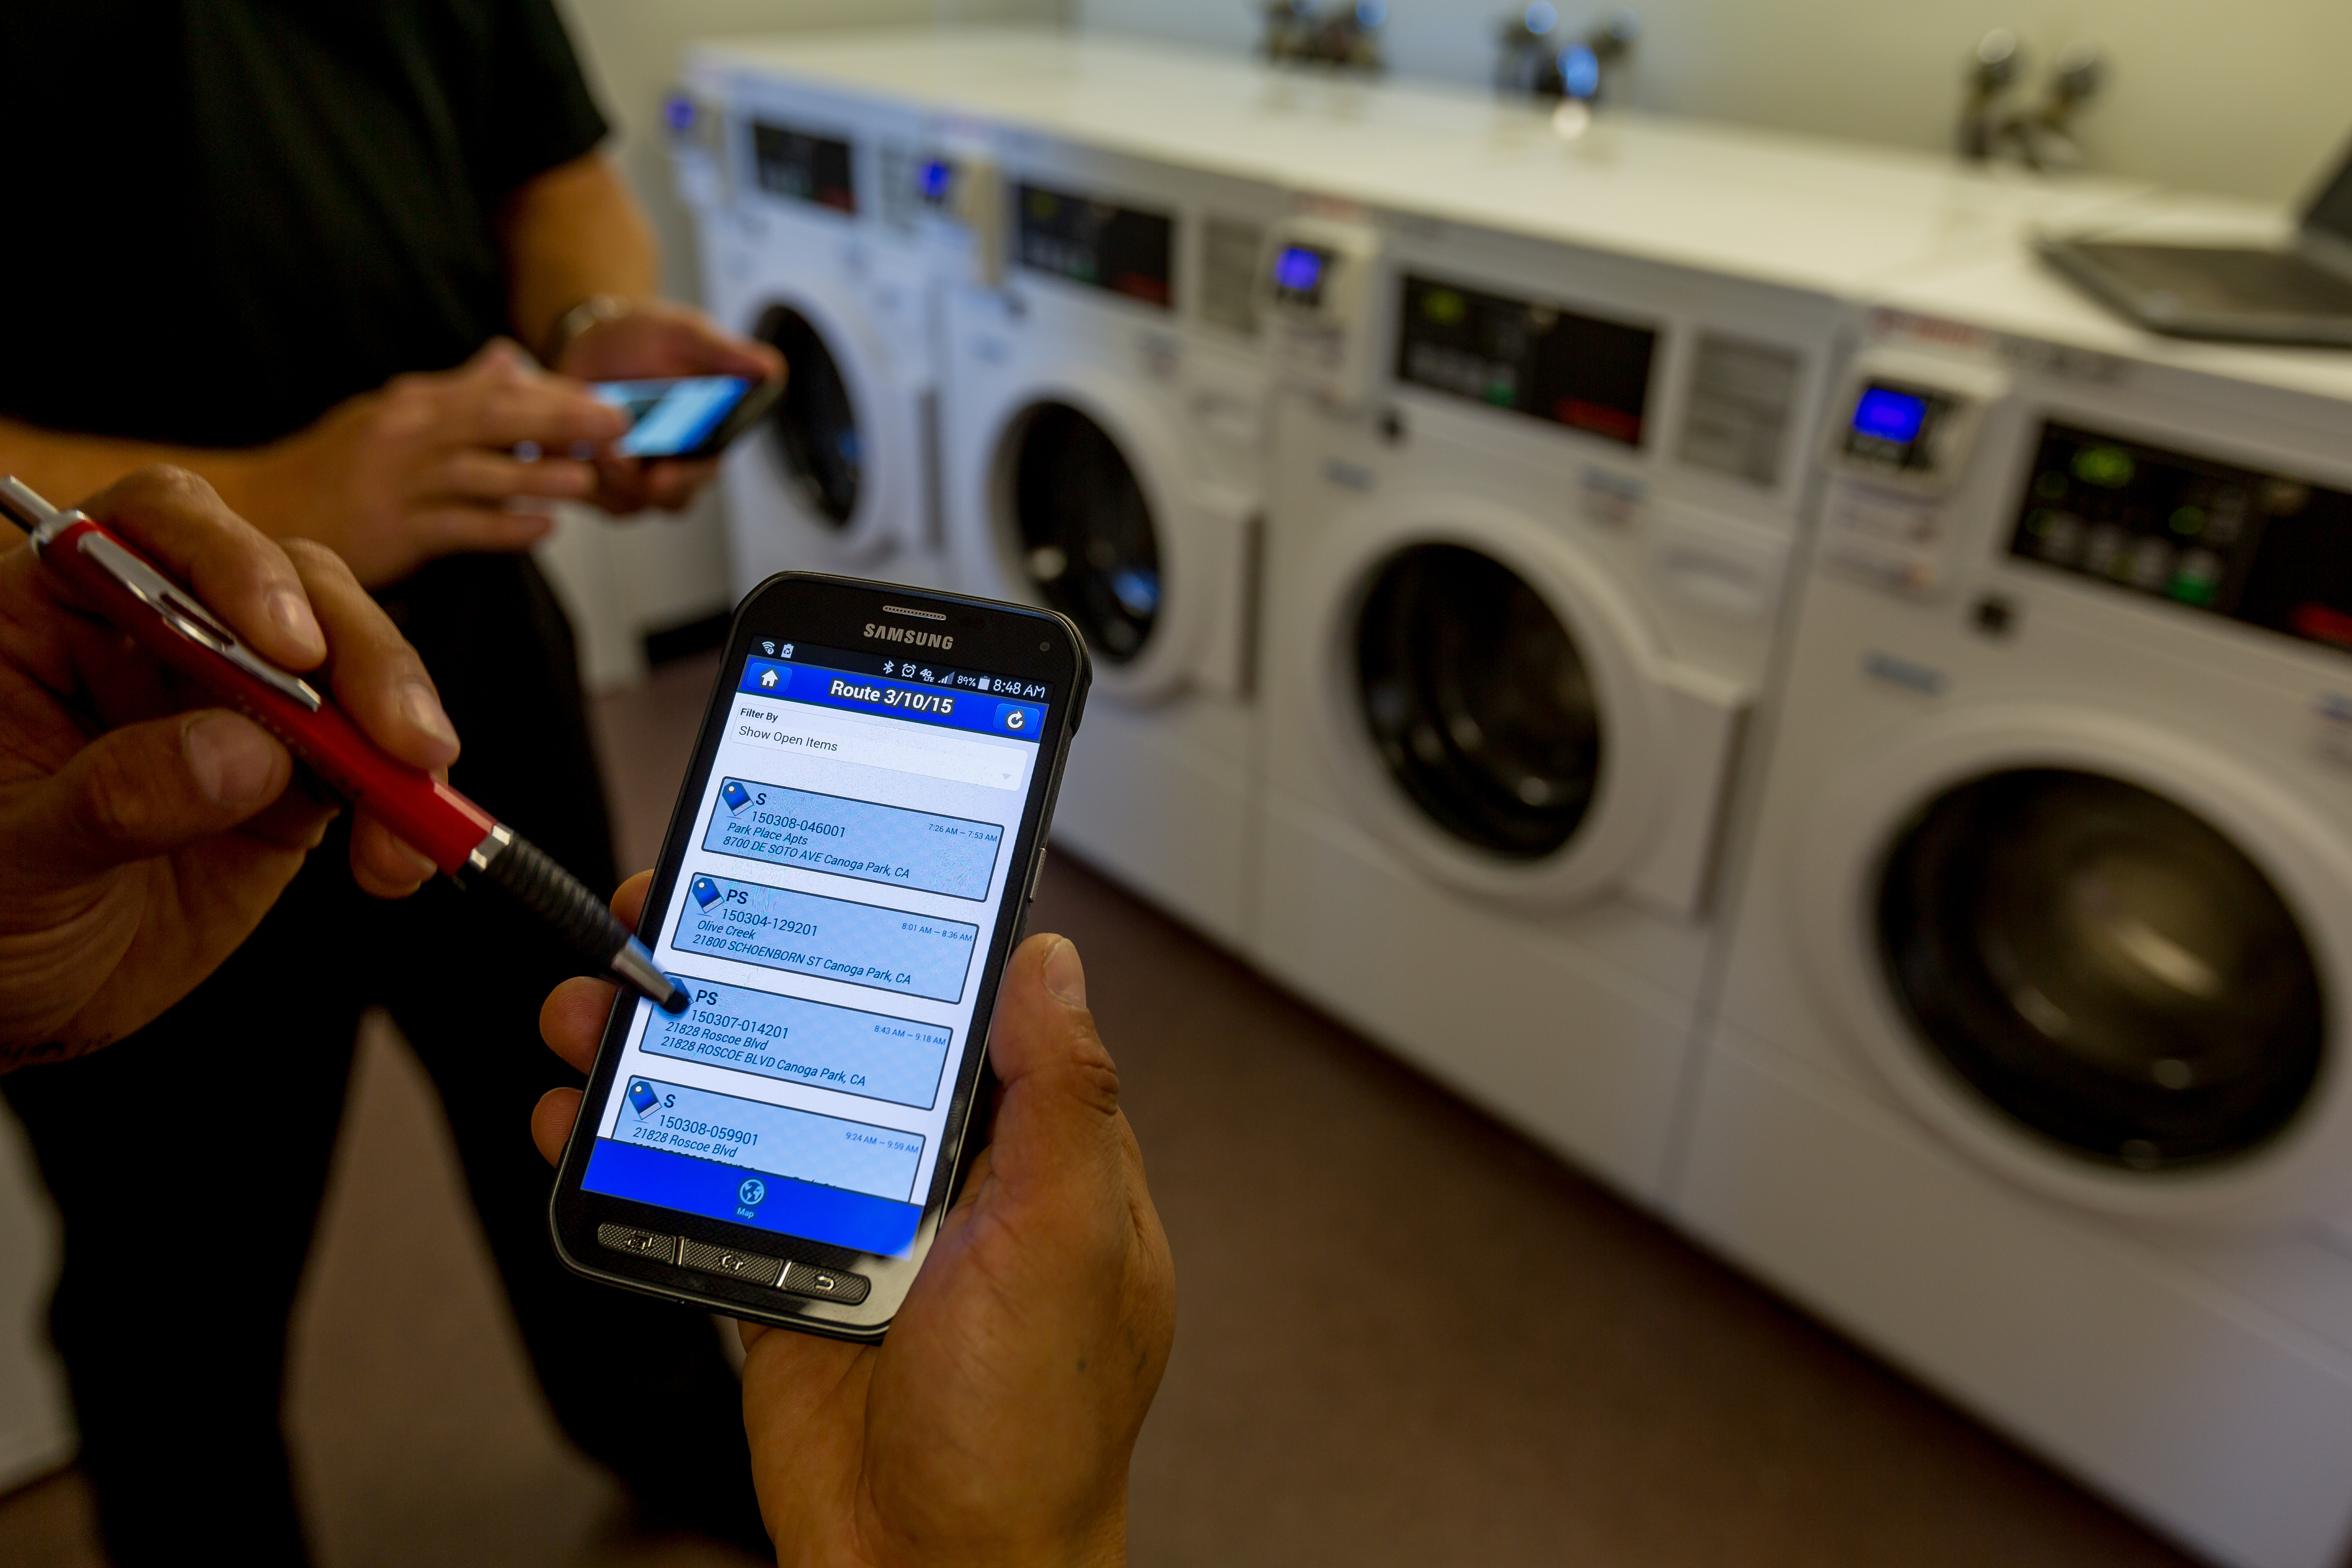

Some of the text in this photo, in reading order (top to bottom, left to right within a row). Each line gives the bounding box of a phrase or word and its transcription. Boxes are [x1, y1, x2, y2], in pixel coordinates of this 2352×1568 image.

[864, 623, 953, 649] SAMSUNG
[920, 668, 932, 677] 4G
[830, 680, 953, 713] Route 3/10/15
[956, 675, 1045, 698] 89% 8:48 AM
[740, 708, 778, 723] Filter By
[739, 725, 838, 751] Show Open Items
[755, 792, 767, 806] S
[727, 822, 808, 845] Park Place Apts
[751, 811, 845, 838] 150308-046001
[928, 823, 944, 832] 7:26
[945, 826, 958, 835] AM
[968, 830, 983, 840] 7:53
[985, 834, 998, 842] AM
[723, 836, 909, 879] 8700 DE SOTO AVE Canoga Park, CA
[726, 889, 749, 904] PS
[697, 920, 756, 940] Olive Creek
[723, 908, 817, 936] 150304-129201
[902, 923, 917, 932] 8:01
[919, 926, 932, 935] AM
[941, 930, 958, 939] 8:36
[959, 934, 972, 942] AM
[692, 934, 911, 985] 21800 SCHOENBORN ST Canoga Park, CA
[695, 989, 718, 1005] PS
[692, 1009, 789, 1039] 150307-014201
[874, 1025, 890, 1035] 8:43
[892, 1029, 906, 1037] AM
[915, 1033, 931, 1043] 9:18
[932, 1037, 946, 1046] AM
[665, 1021, 770, 1051] 21828 Roscoe Blvd
[661, 1036, 866, 1086] 21828 ROSCOE BLVD Canoga Park, CA
[663, 1094, 676, 1108] S
[659, 1115, 758, 1146] 150308-059901
[632, 1127, 738, 1158] 21828 Roscoe Blvd
[845, 1131, 862, 1142] 9:24
[863, 1135, 877, 1145] AM
[904, 1144, 919, 1154] AM
[736, 1207, 755, 1219] Map
